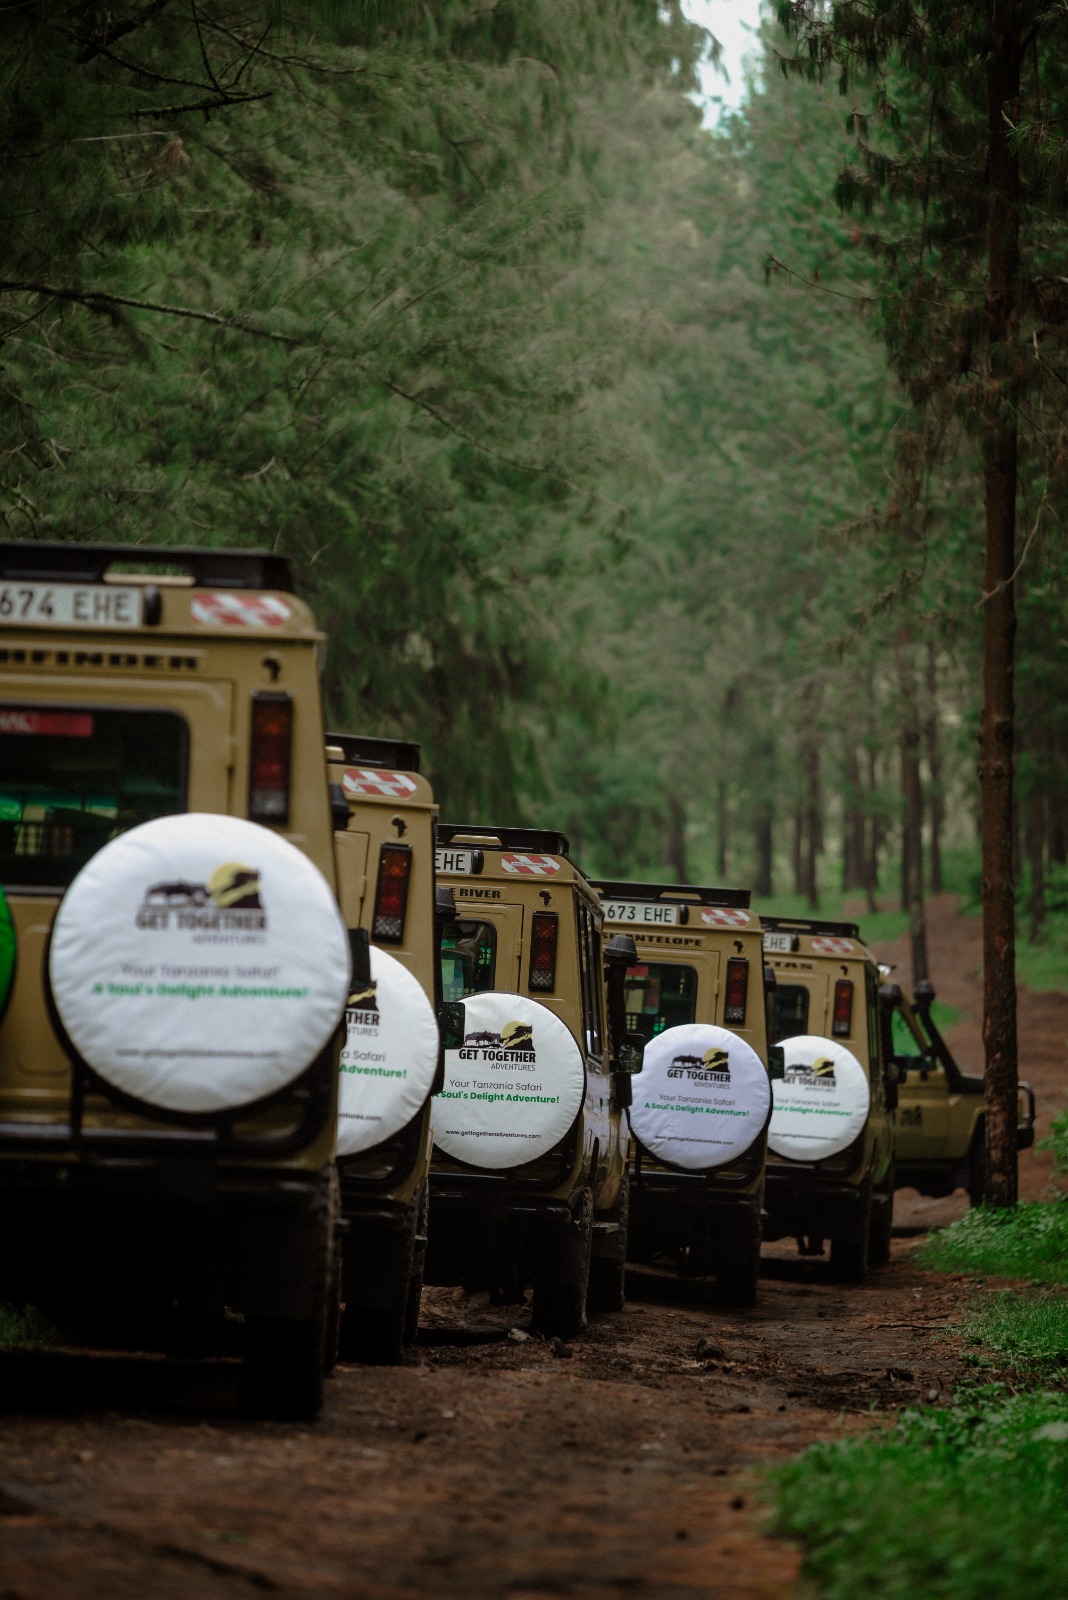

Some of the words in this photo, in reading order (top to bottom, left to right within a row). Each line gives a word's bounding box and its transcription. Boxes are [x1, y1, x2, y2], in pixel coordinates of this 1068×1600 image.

[0, 588, 53, 617] 674
[73, 591, 131, 621] EHE
[459, 888, 501, 899] RIVER
[607, 904, 636, 920] 673
[644, 907, 672, 923] EHE
[136, 911, 169, 930] GET
[177, 912, 268, 931] TOGETHER
[346, 1010, 380, 1026] THER
[352, 1050, 386, 1063] Safari
[459, 1049, 479, 1060] GET
[483, 1050, 536, 1063] TOGETHER
[339, 1063, 407, 1079] Adventure!
[491, 1063, 536, 1072] ADVENTURES
[667, 1069, 683, 1079] GET
[687, 1070, 731, 1082] TOGETHER
[798, 1077, 836, 1087] TOGETHER
[450, 1080, 471, 1088] Your
[472, 1080, 514, 1090] Tanzania
[515, 1082, 542, 1092] Safari
[693, 1081, 731, 1090] ADVENTURES
[440, 1090, 469, 1099] Soul's
[470, 1091, 505, 1103] Delight
[505, 1094, 560, 1104] Adventure!
[659, 1093, 676, 1102] Your
[678, 1095, 712, 1105] Tanzania
[713, 1098, 736, 1107] Safari
[651, 1102, 674, 1111] Soul's
[675, 1104, 704, 1114] Delight
[705, 1106, 750, 1117] Adventure!
[445, 1130, 542, 1139] www.gettogetheradventures.com
